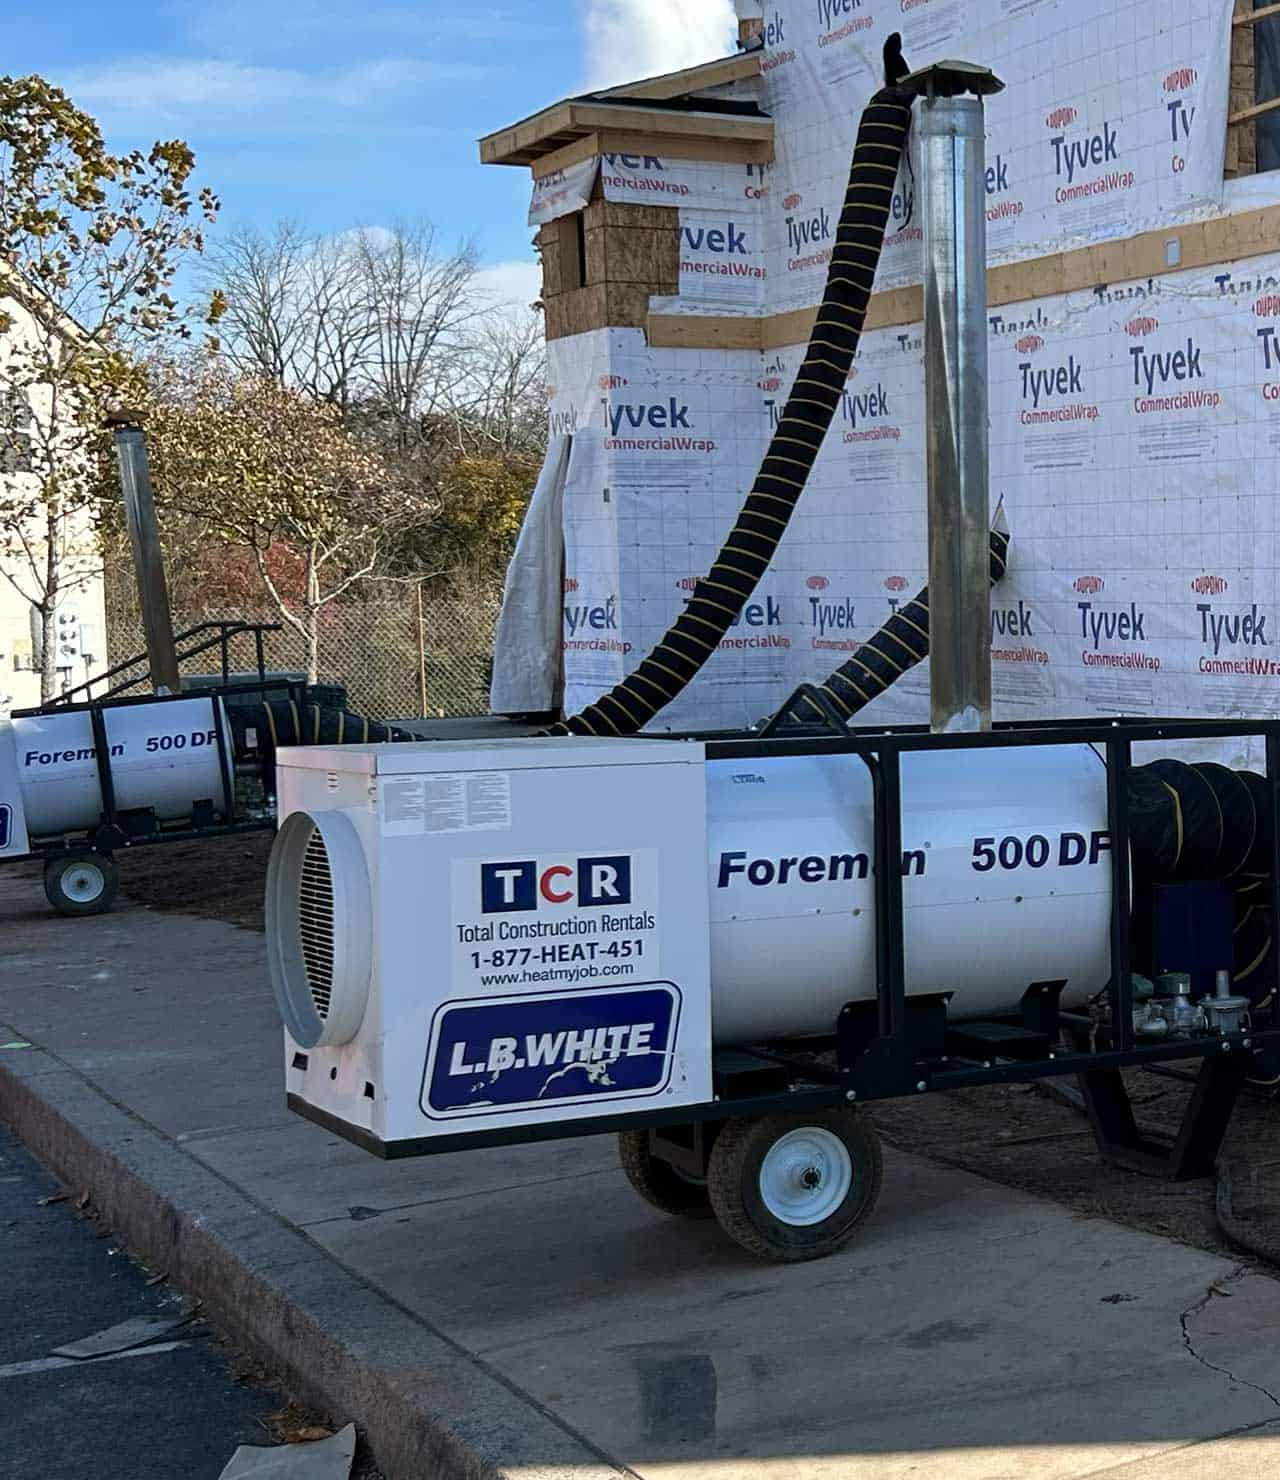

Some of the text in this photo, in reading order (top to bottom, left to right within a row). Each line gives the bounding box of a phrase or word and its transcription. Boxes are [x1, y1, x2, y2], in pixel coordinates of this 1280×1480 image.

[1051, 122, 1117, 183] Tyvek
[1055, 170, 1134, 204] CommercialWrap
[677, 222, 747, 255] vek
[786, 208, 830, 256] Tyvek
[1019, 356, 1082, 408] Tyvek
[1129, 338, 1201, 395] Tyvek
[843, 384, 889, 428] Tyvek
[1021, 406, 1098, 424] CommercialWrap
[1134, 391, 1220, 414] CommercialWrap
[809, 597, 855, 636] Tyvek
[1078, 602, 1145, 650] Tyvek
[1197, 604, 1268, 655] Tyvek
[1082, 650, 1160, 671] CommercialWrap
[25, 730, 218, 767] Foremn 500 DF
[718, 831, 1112, 888] Foremn 500 DF
[494, 863, 621, 905] TCR
[456, 911, 656, 943] Total Construction Rentals
[471, 939, 643, 969] 1-877-HEAT-451
[481, 962, 634, 986] www.heatmyjob.com
